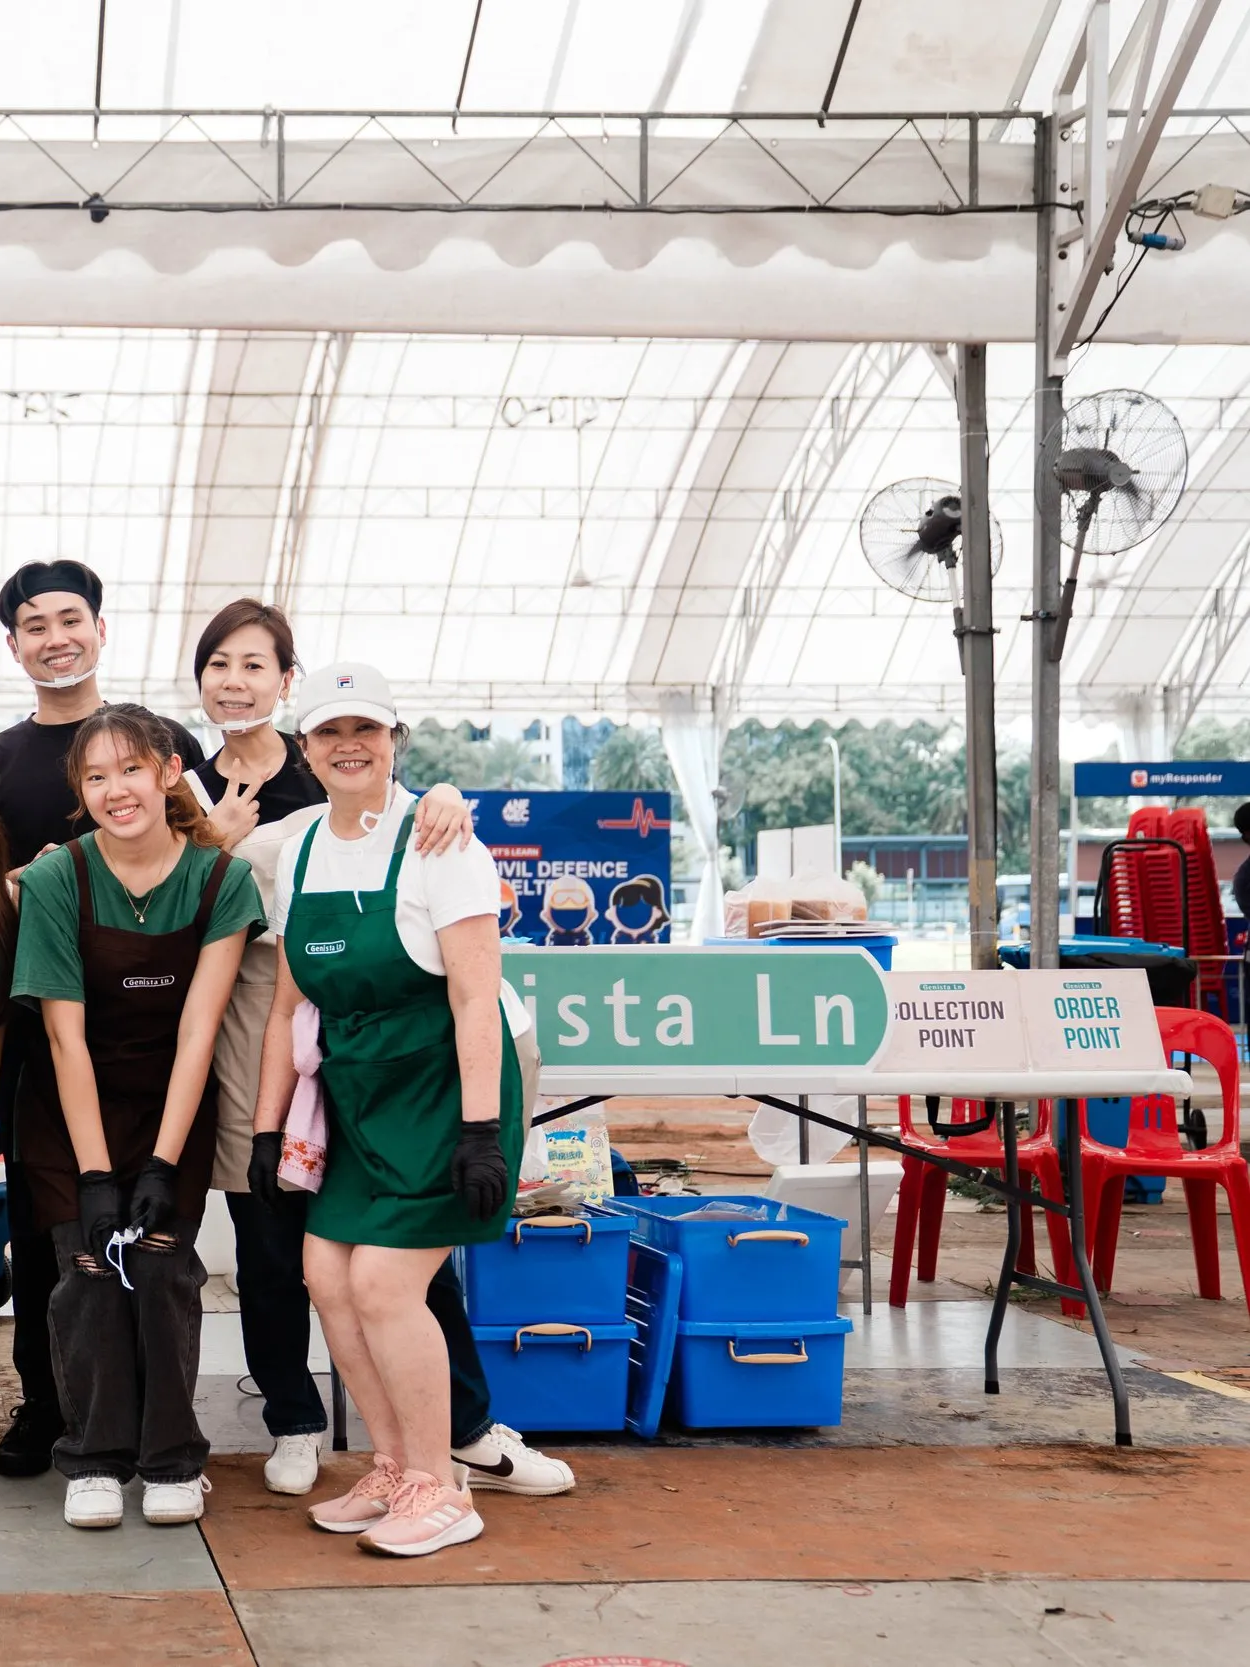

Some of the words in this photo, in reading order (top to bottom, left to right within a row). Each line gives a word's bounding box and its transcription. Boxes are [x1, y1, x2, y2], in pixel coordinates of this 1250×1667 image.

[1150, 773, 1223, 785] myResponder
[511, 847, 539, 857] LEARN
[494, 861, 533, 878] IVIL
[537, 861, 628, 878] DEFENCE
[310, 944, 335, 952] Genista
[523, 973, 694, 1047] ista
[756, 973, 856, 1046] Ln
[1054, 997, 1120, 1019] ORDER
[919, 1029, 976, 1048] POINT
[1063, 1027, 1120, 1049] POINT
